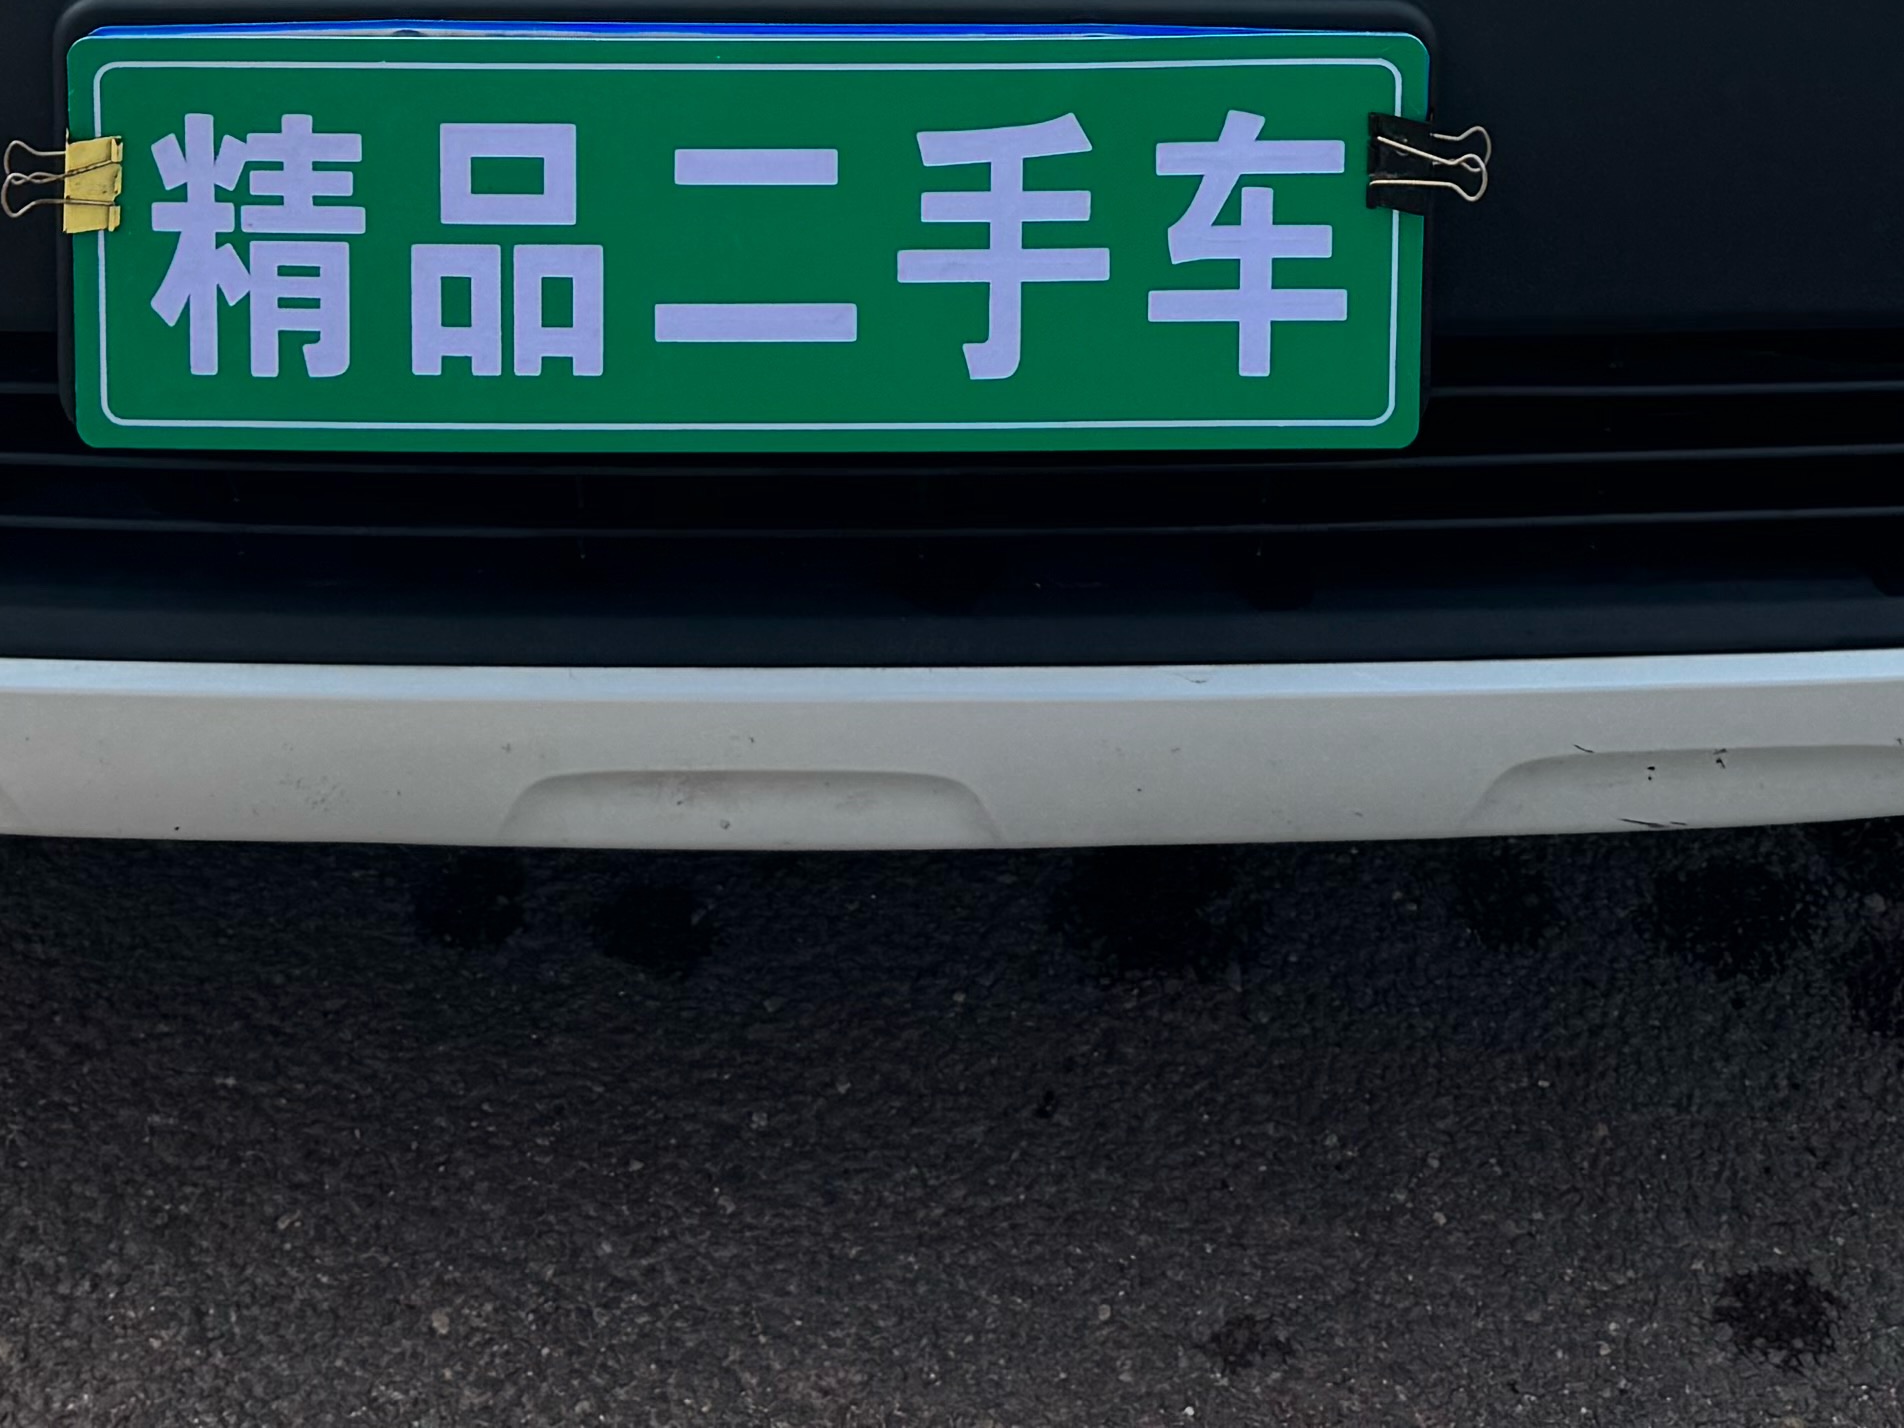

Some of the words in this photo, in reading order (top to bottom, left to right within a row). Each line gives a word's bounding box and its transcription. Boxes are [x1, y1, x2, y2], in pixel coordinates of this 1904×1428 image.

[150, 110, 1348, 380] 精品二手车
